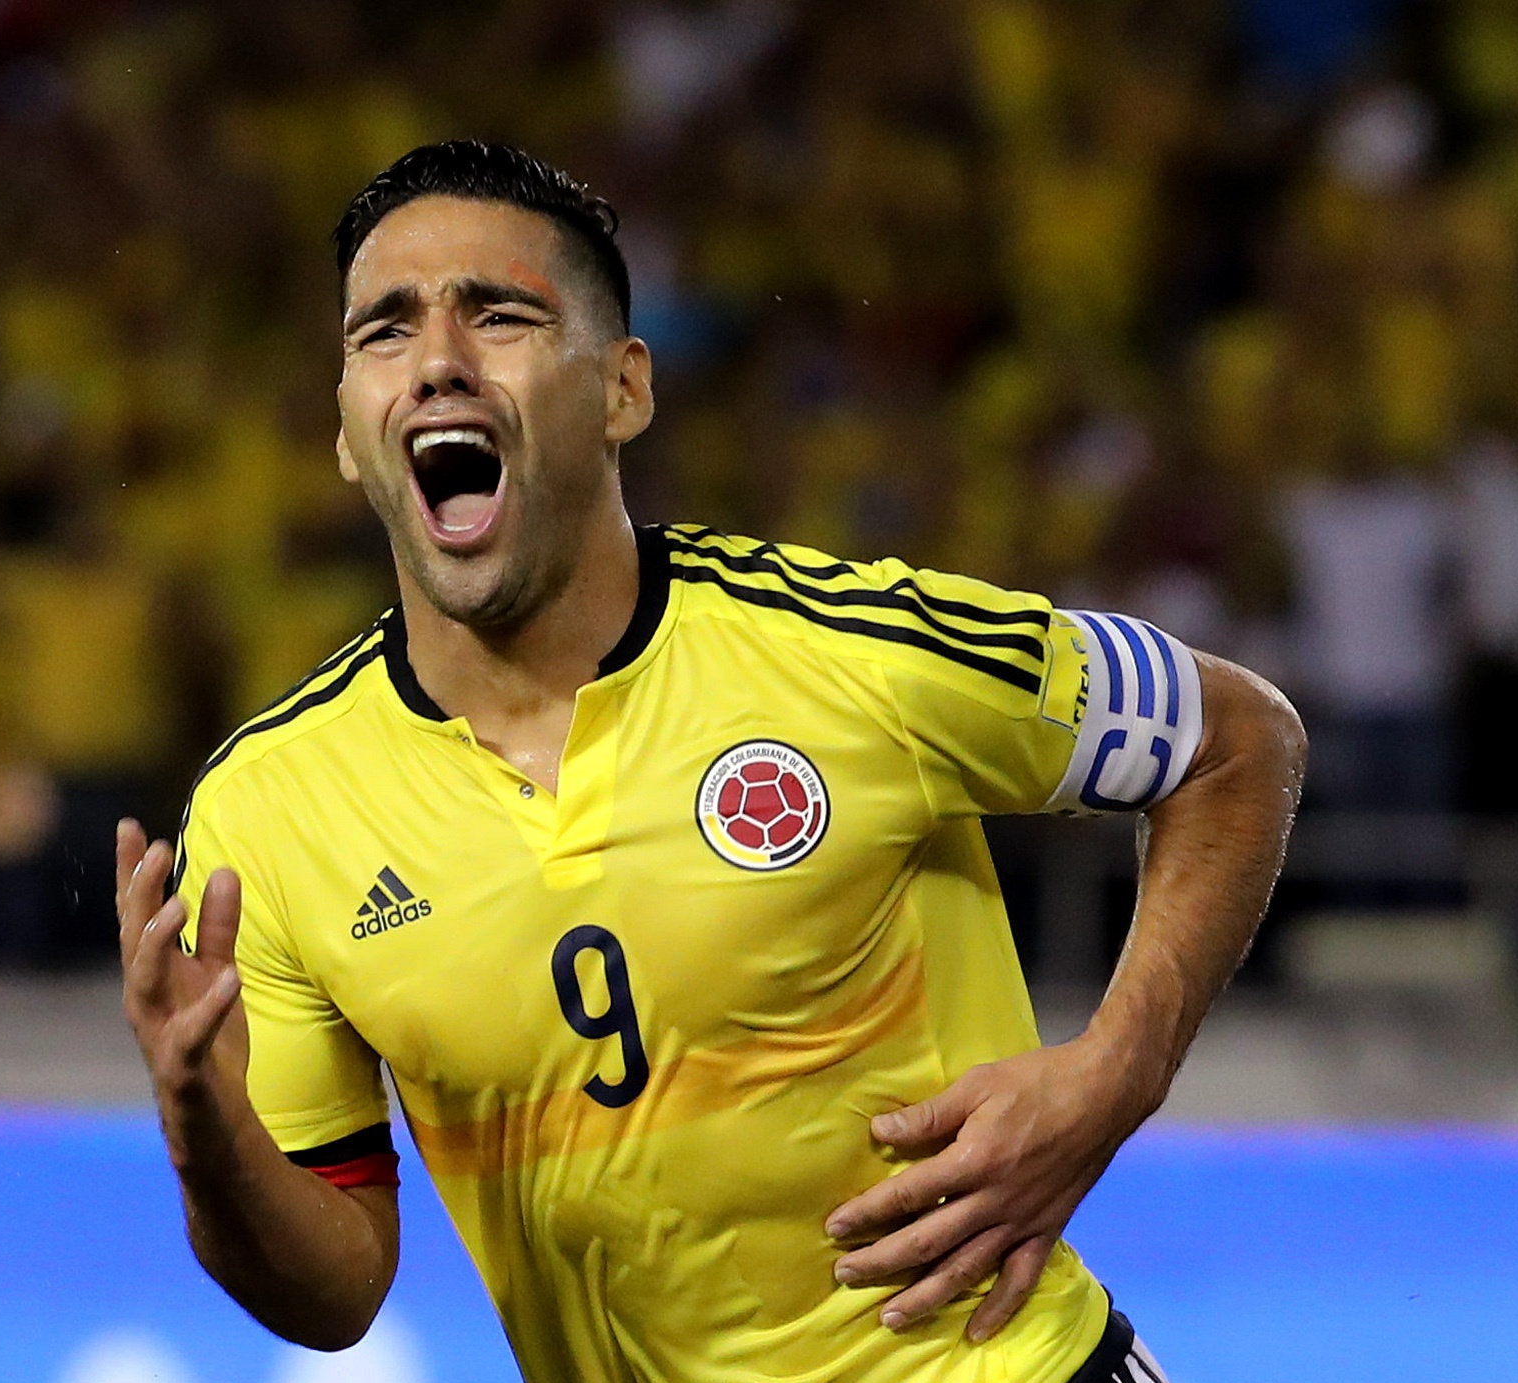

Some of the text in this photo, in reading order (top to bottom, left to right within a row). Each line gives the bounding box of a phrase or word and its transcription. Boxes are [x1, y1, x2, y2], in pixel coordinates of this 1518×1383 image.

[730, 748, 788, 765] COLOMBIANA
[788, 758, 800, 768] DE
[351, 899, 432, 940] adidas
[551, 924, 650, 1108] 9
